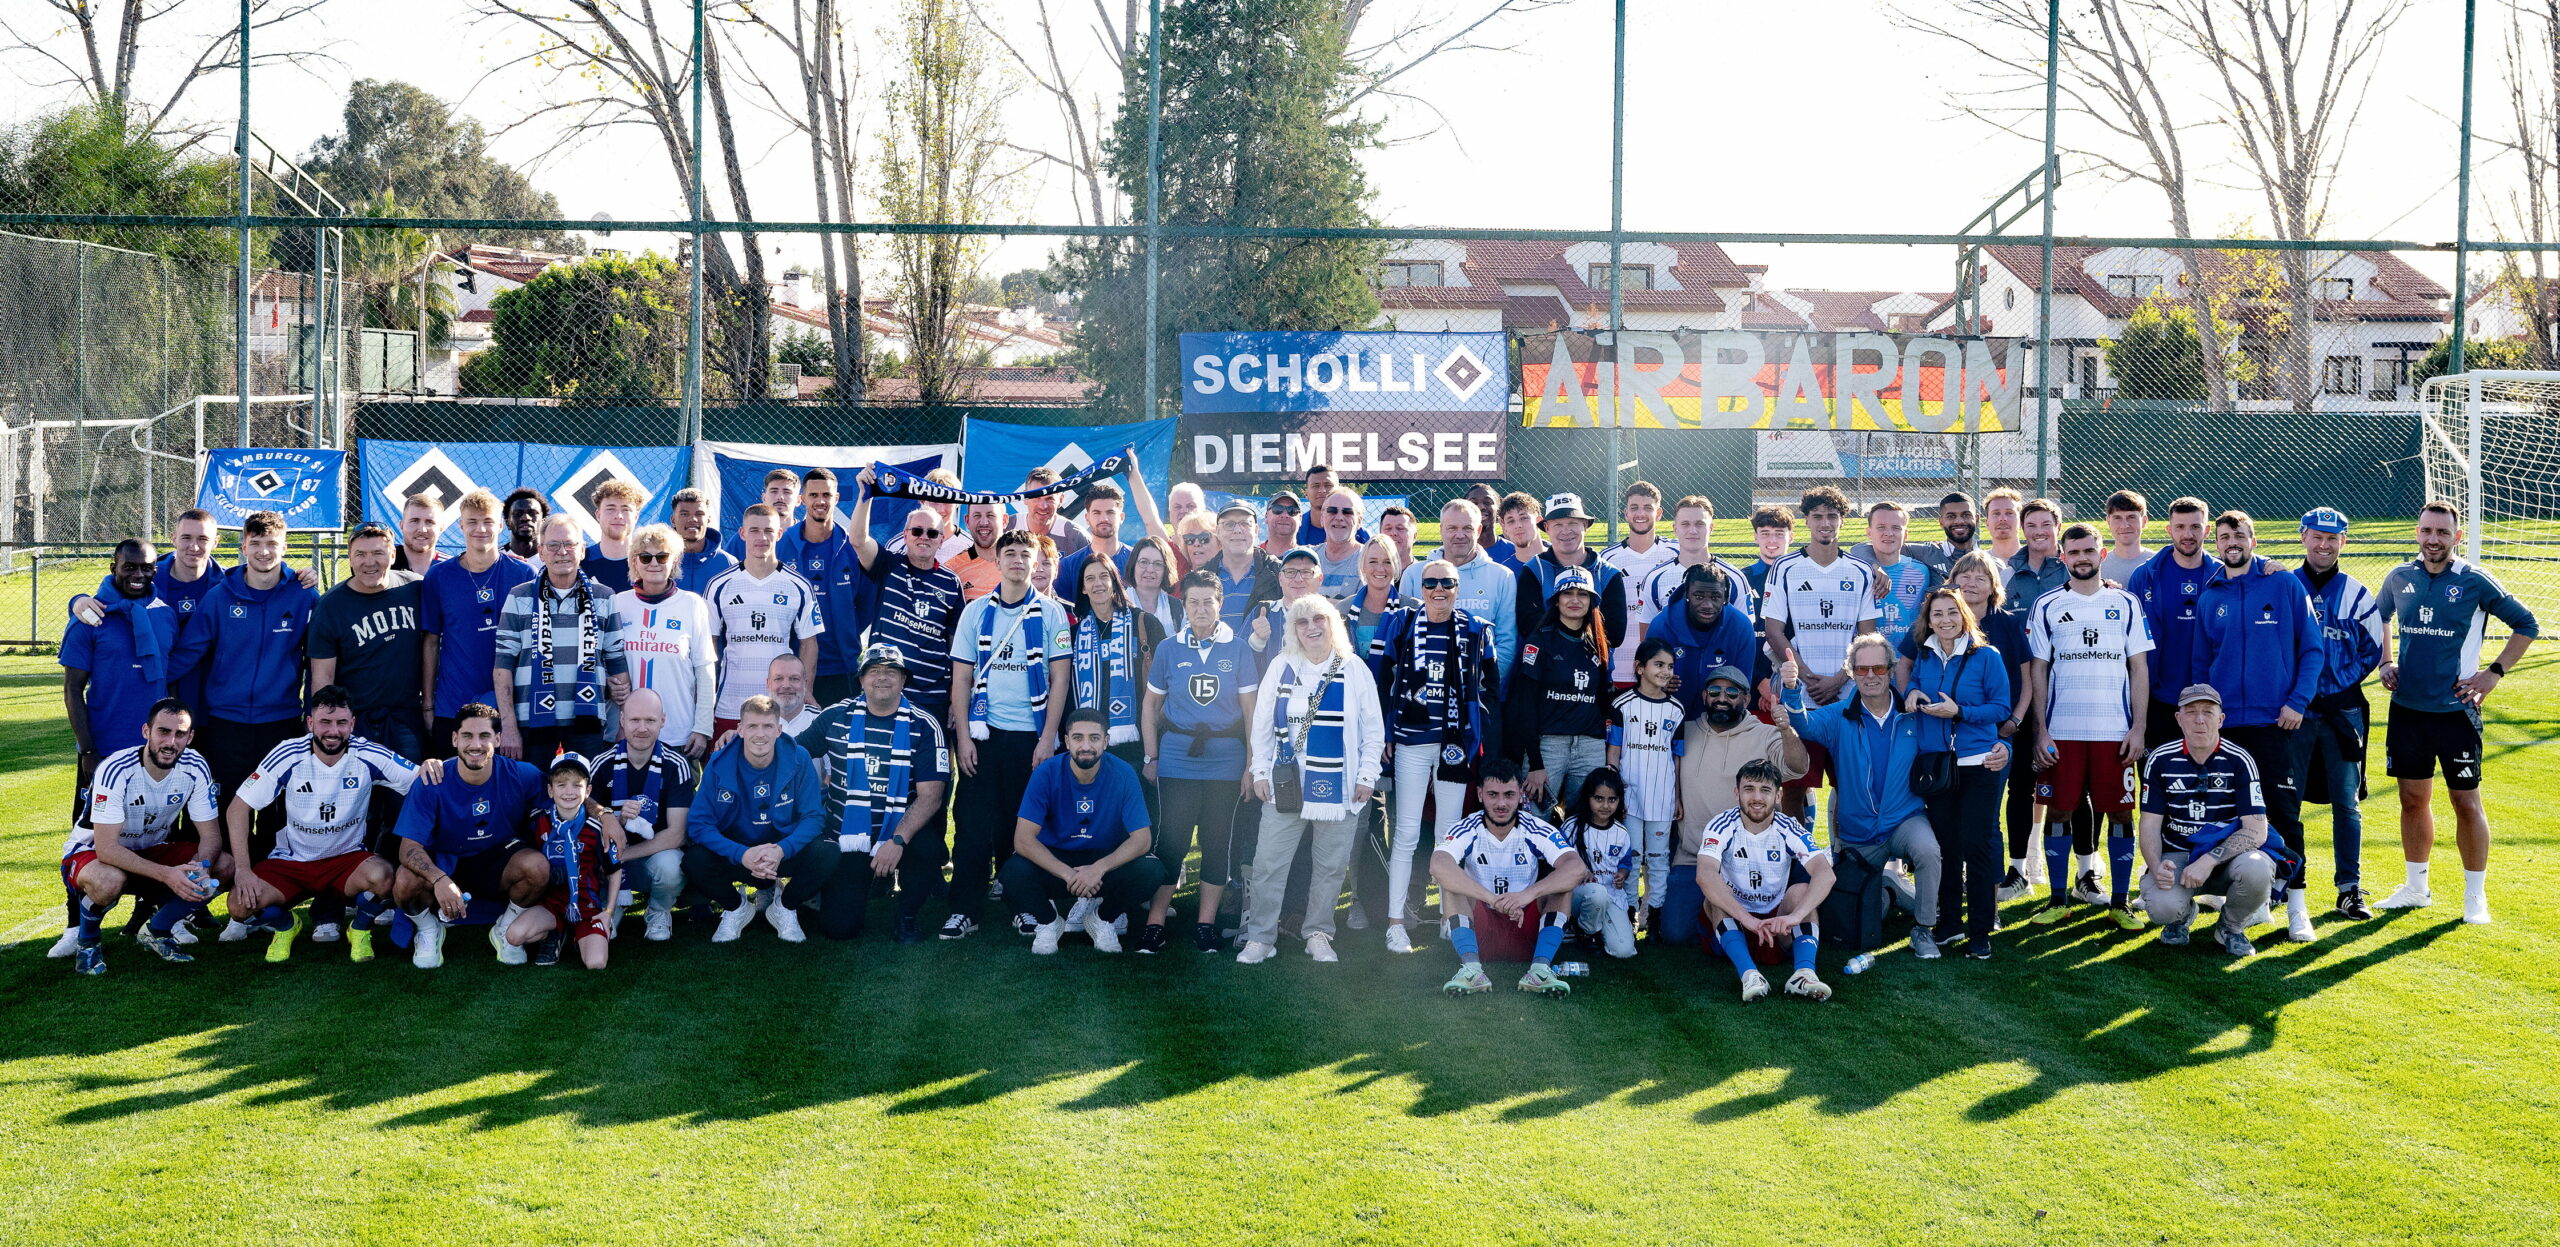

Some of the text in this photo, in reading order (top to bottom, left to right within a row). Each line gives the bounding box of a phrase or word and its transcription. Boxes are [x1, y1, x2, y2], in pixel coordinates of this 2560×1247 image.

[1192, 353, 1425, 394] SCHOLLI
[1194, 432, 1498, 474] DIEMELSEE
[1868, 459, 1941, 471] FACILITIES
[221, 475, 321, 492] 18 87
[288, 495, 318, 516] CLUB
[1454, 598, 1490, 610] BURG
[352, 605, 416, 647] MOIN
[893, 611, 942, 637] HanseMerkur
[1798, 621, 1853, 632] HanseMerkur
[2401, 625, 2455, 637] HanseMerkur
[640, 630, 657, 640] Fly
[2324, 626, 2350, 641] RP
[625, 639, 680, 654] mirates
[1078, 616, 1092, 671] GER
[1110, 611, 1125, 679] HAM
[2059, 651, 2122, 661] HanseMerkur
[1195, 679, 1215, 697] 15
[1447, 686, 1459, 730] 1887
[2123, 767, 2135, 792] 6
[292, 817, 361, 835] HanseMerkur
